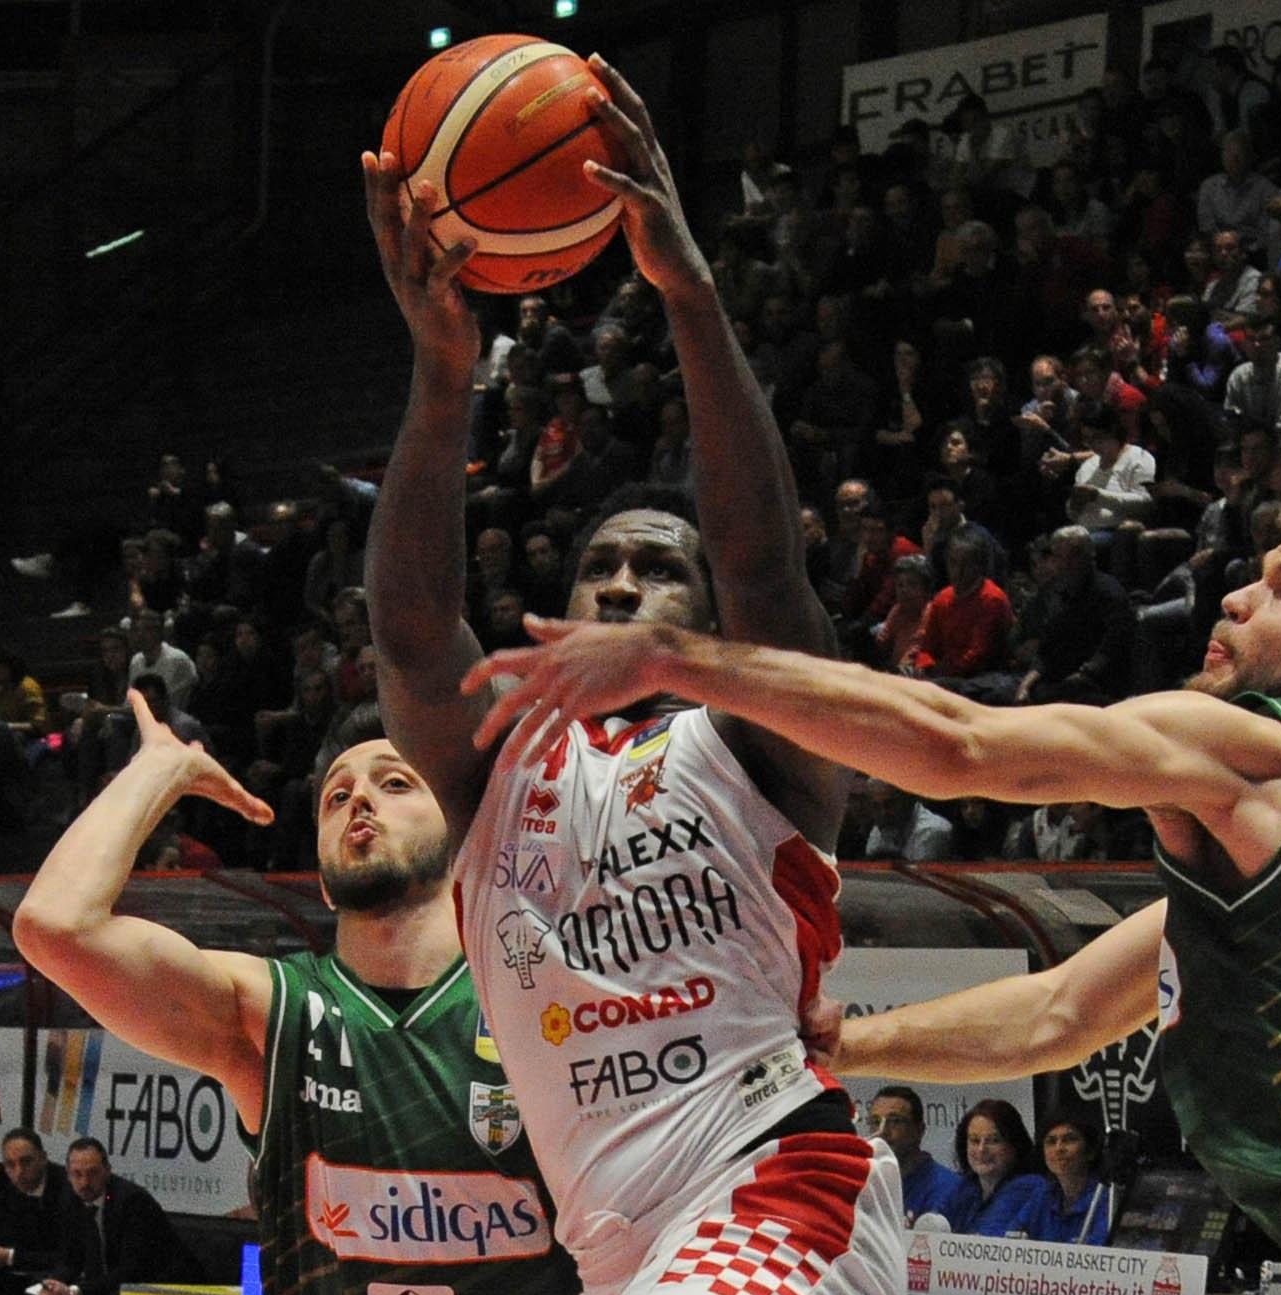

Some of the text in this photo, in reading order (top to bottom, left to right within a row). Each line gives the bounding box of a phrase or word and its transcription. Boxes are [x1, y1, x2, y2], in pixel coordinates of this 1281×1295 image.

[521, 817, 556, 834] rrea
[574, 977, 715, 1034] CONAD
[569, 1034, 707, 1106] FABO
[105, 1073, 226, 1162] FABO
[939, 1240, 1148, 1277] CONSORZIO PISTOIA BASKET CITY
